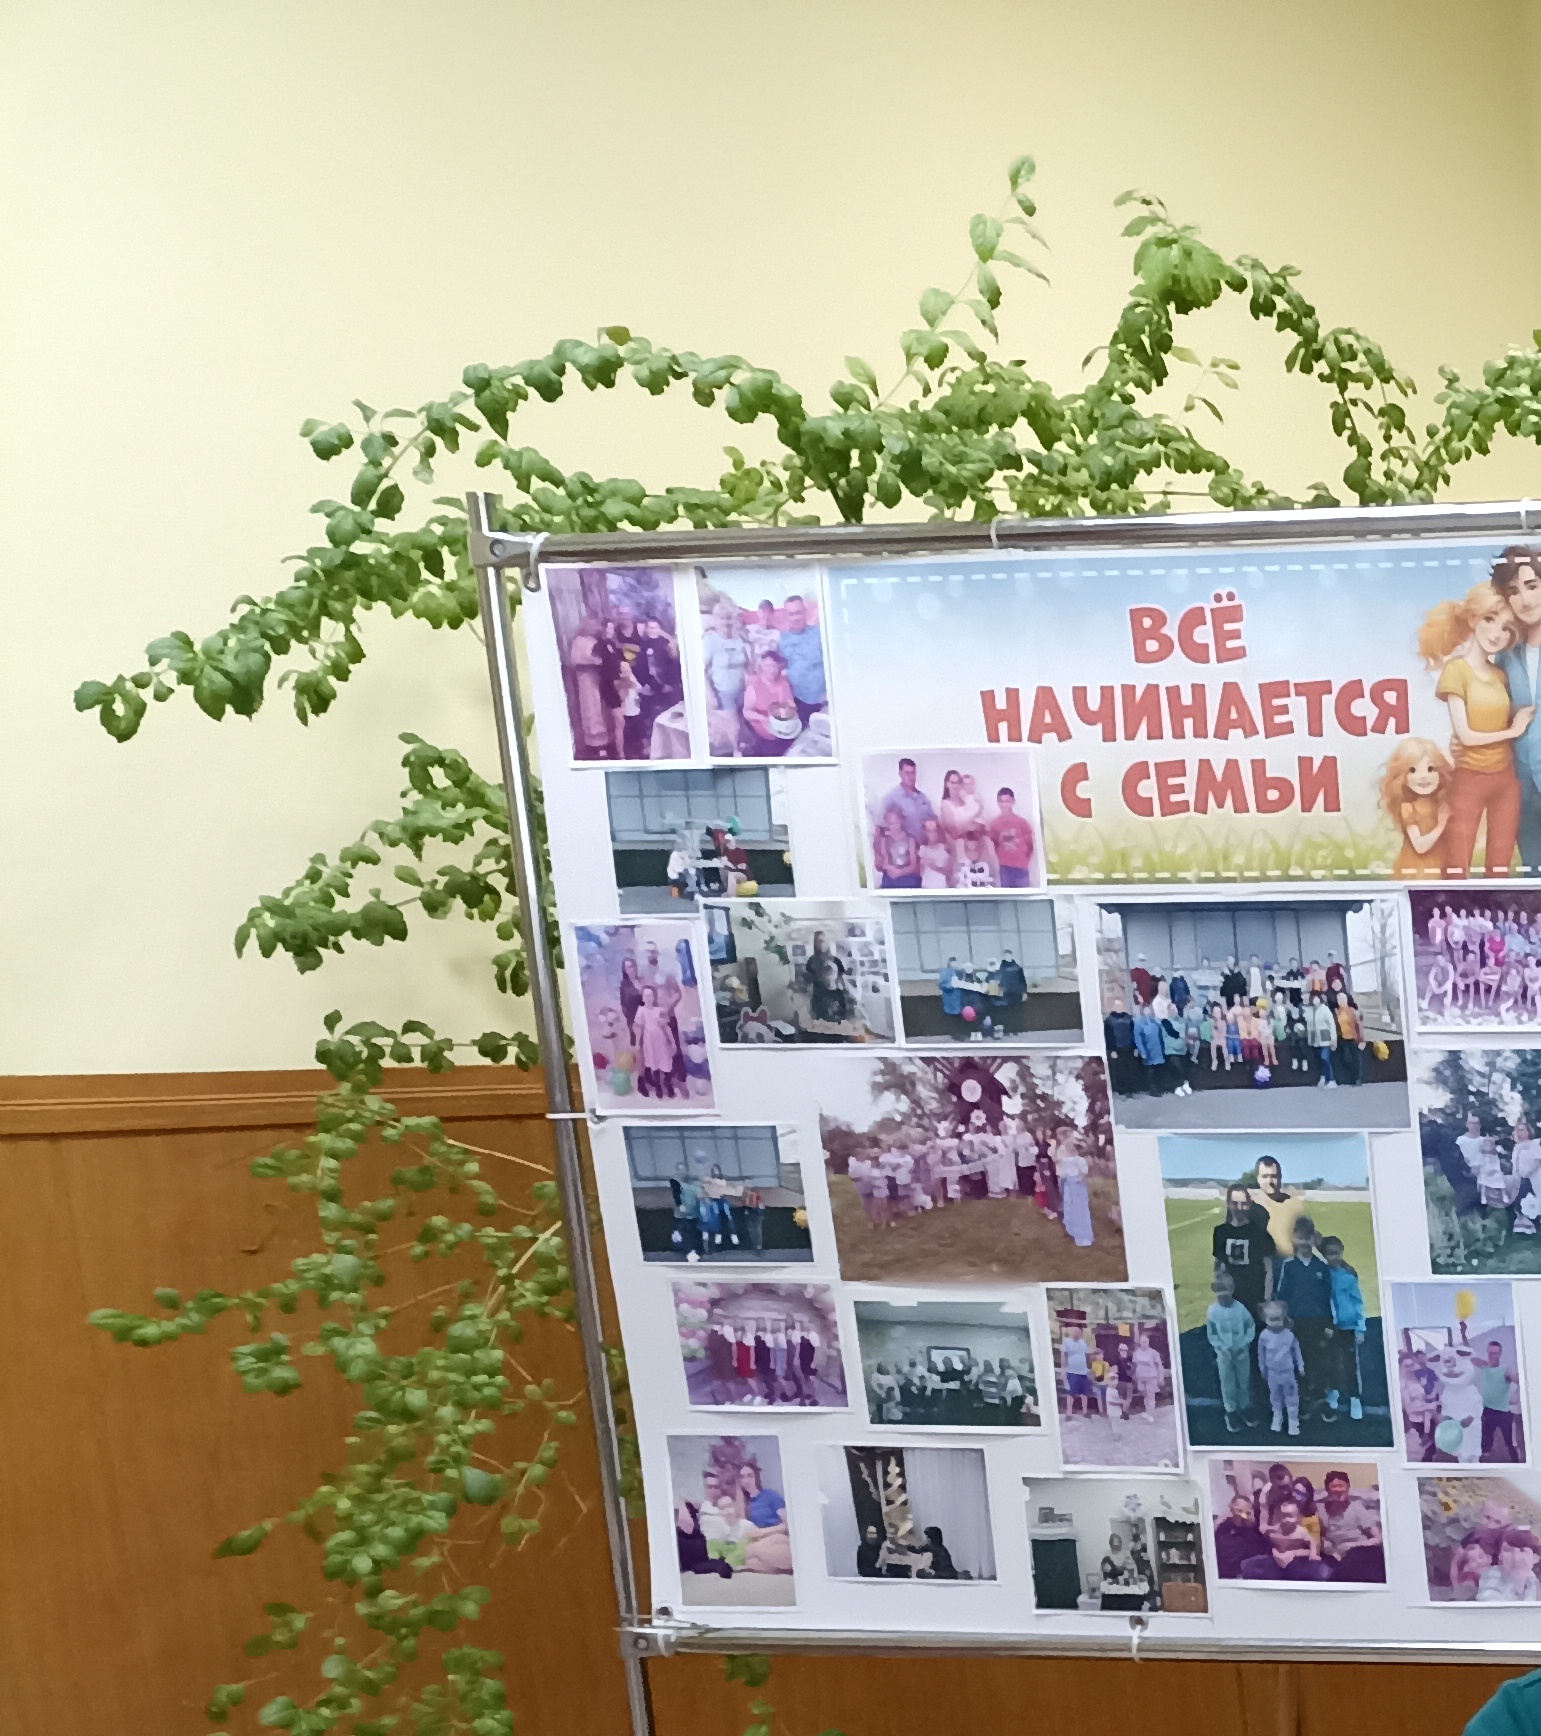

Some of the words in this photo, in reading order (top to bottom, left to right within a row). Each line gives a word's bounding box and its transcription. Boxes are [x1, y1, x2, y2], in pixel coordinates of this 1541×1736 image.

[1128, 588, 1248, 665] ВСЁ
[979, 677, 1411, 744] НАЧИНАЕТСЯ
[1061, 761, 1093, 819] С
[1121, 756, 1342, 817] СЕМЬИ
